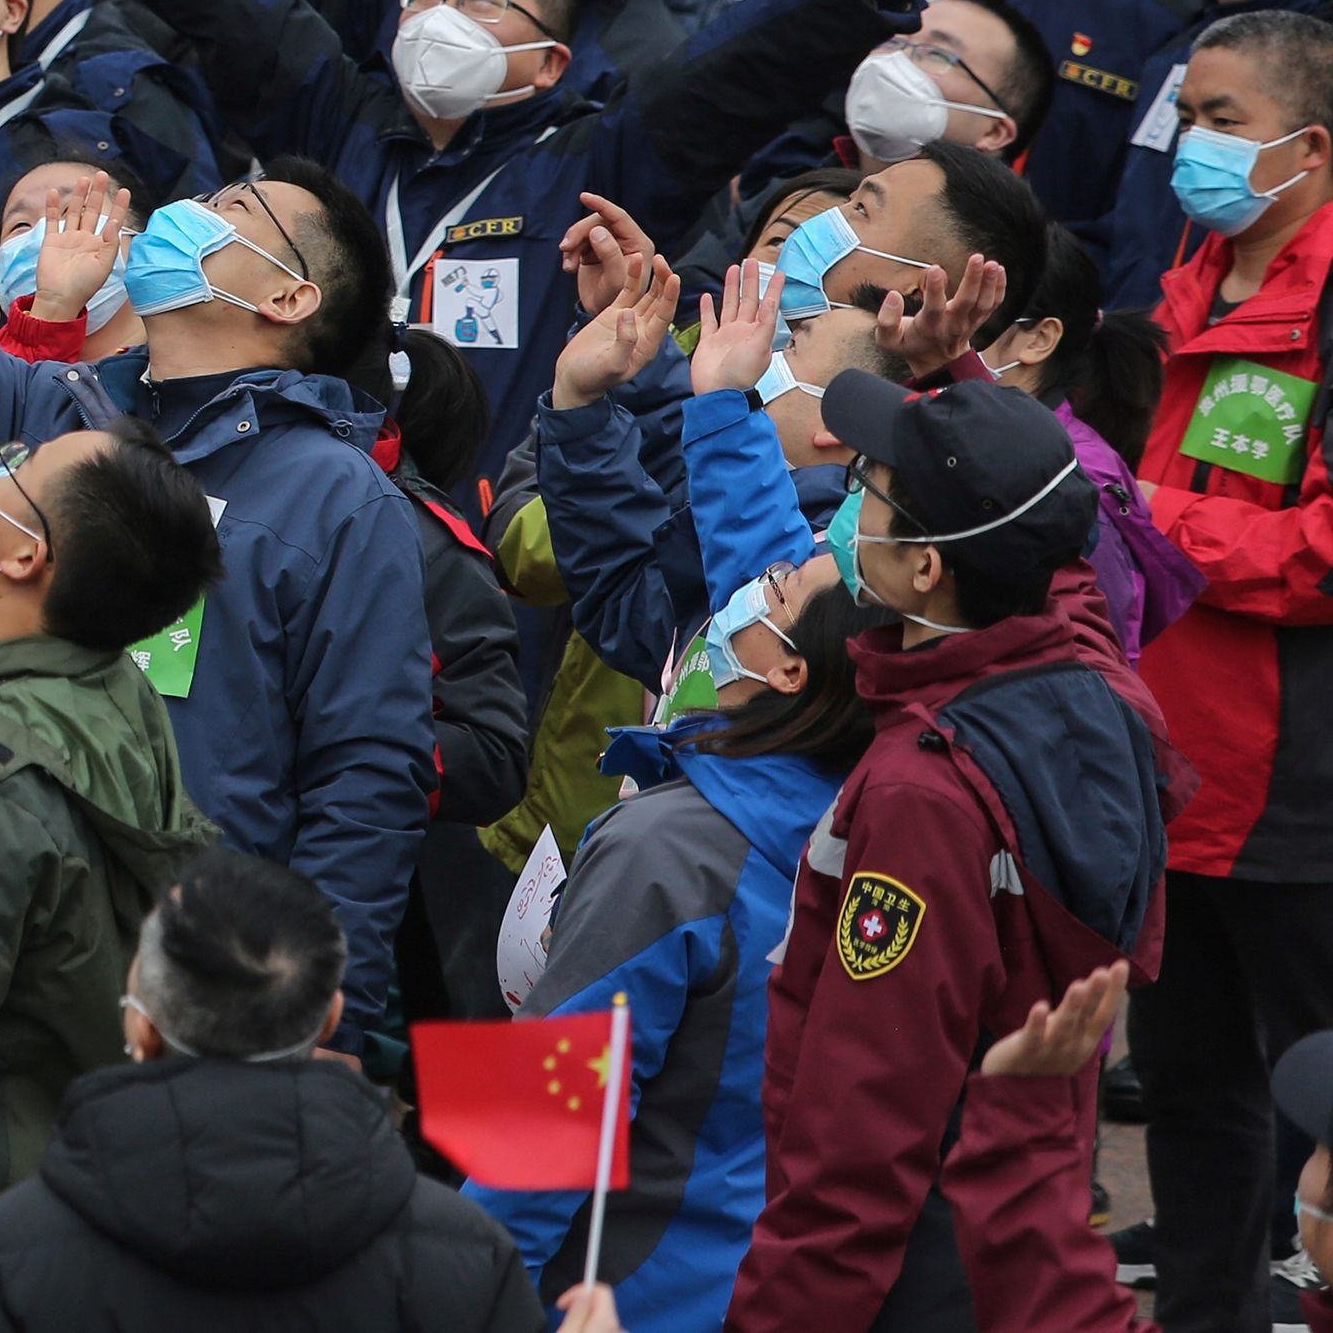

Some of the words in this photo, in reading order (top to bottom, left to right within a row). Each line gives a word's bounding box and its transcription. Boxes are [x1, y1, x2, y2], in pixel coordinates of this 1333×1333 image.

[469, 221, 516, 237] CFR
[862, 881, 910, 913] 中国卫生
